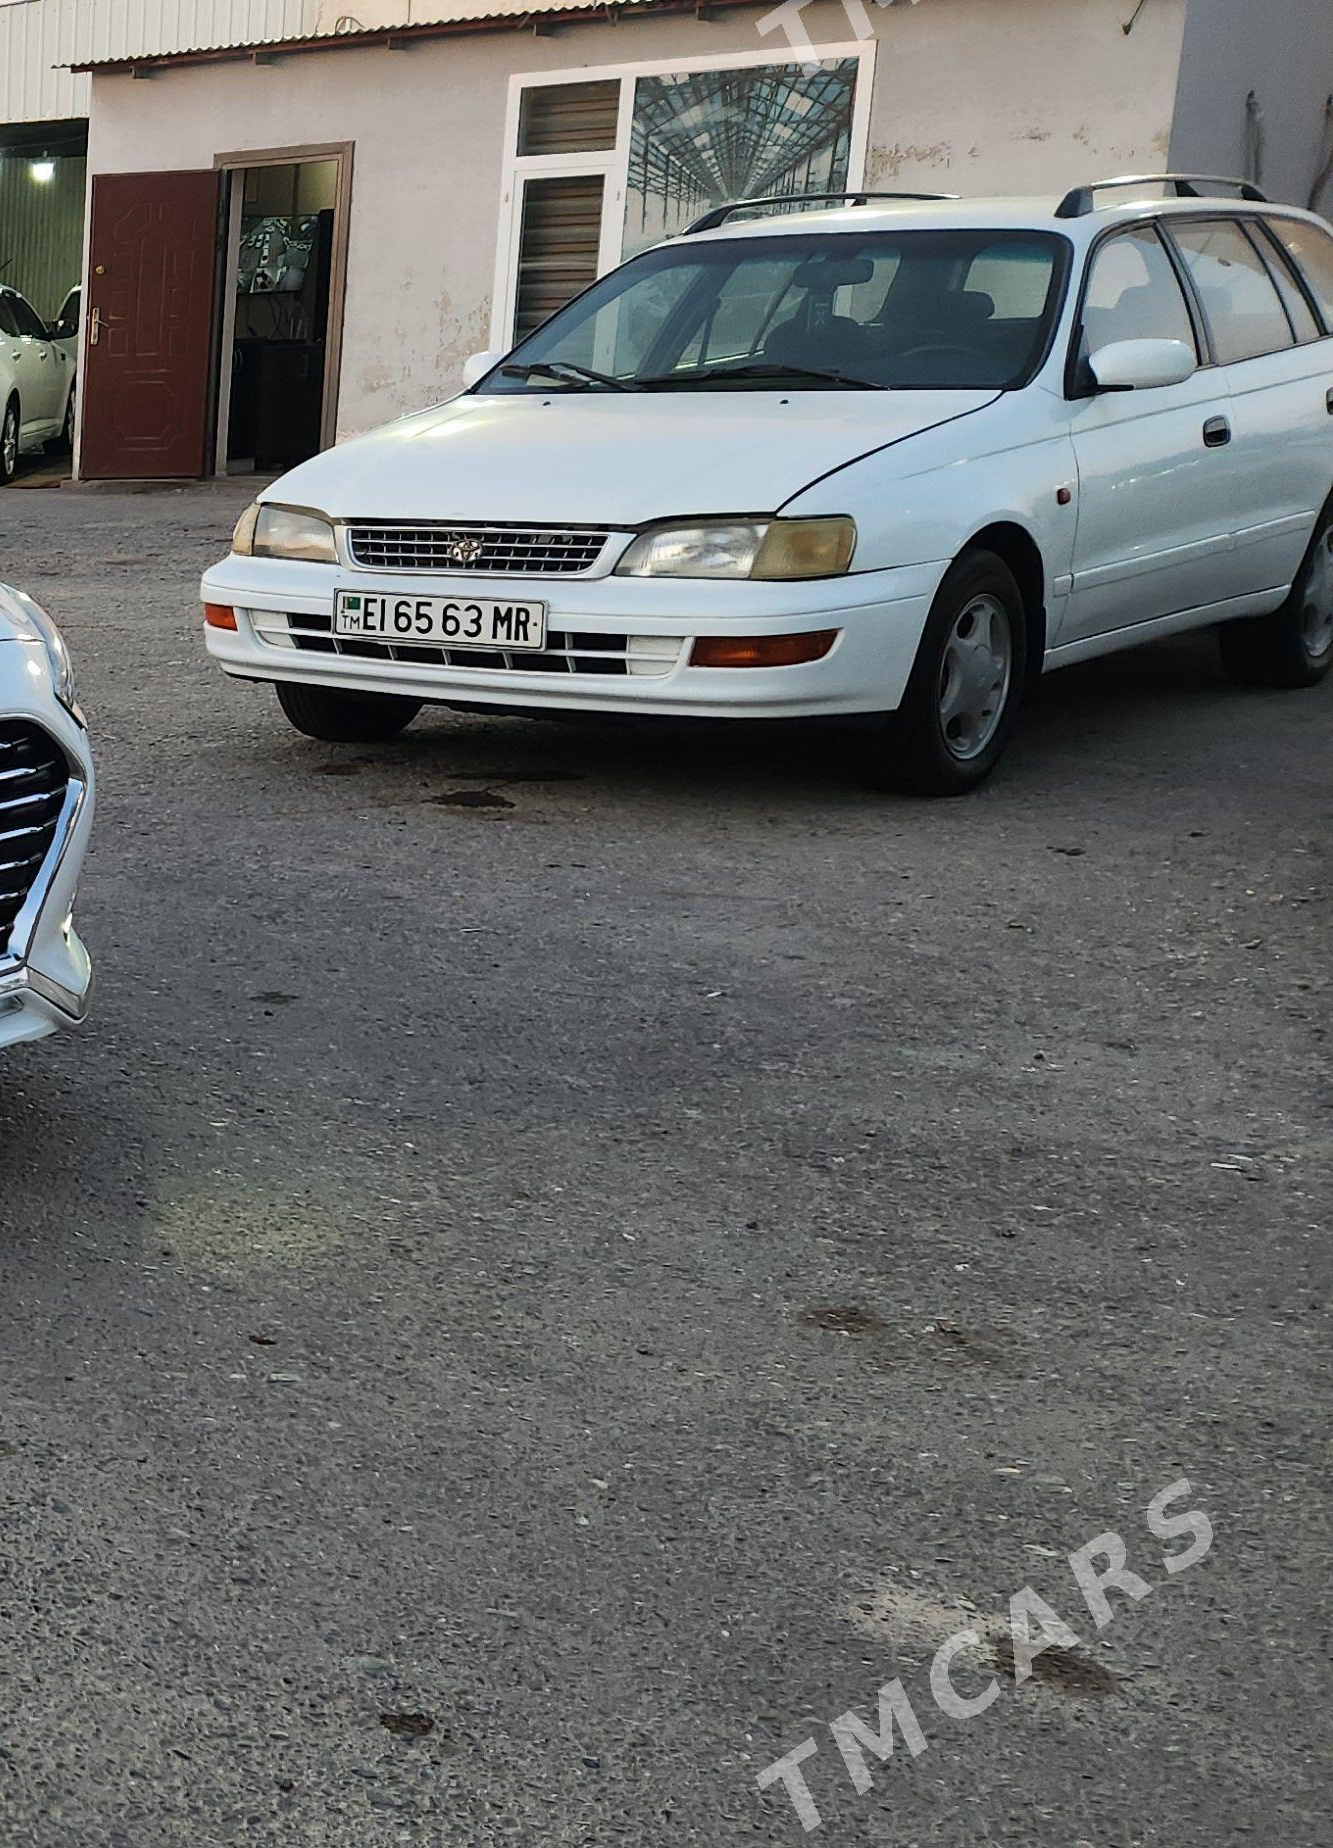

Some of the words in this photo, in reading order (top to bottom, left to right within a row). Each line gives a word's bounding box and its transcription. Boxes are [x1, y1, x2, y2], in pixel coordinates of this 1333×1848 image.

[342, 614, 360, 630] TM
[363, 598, 386, 631] EI
[394, 600, 433, 634] 65
[442, 603, 482, 638] 63
[492, 606, 530, 641] MR
